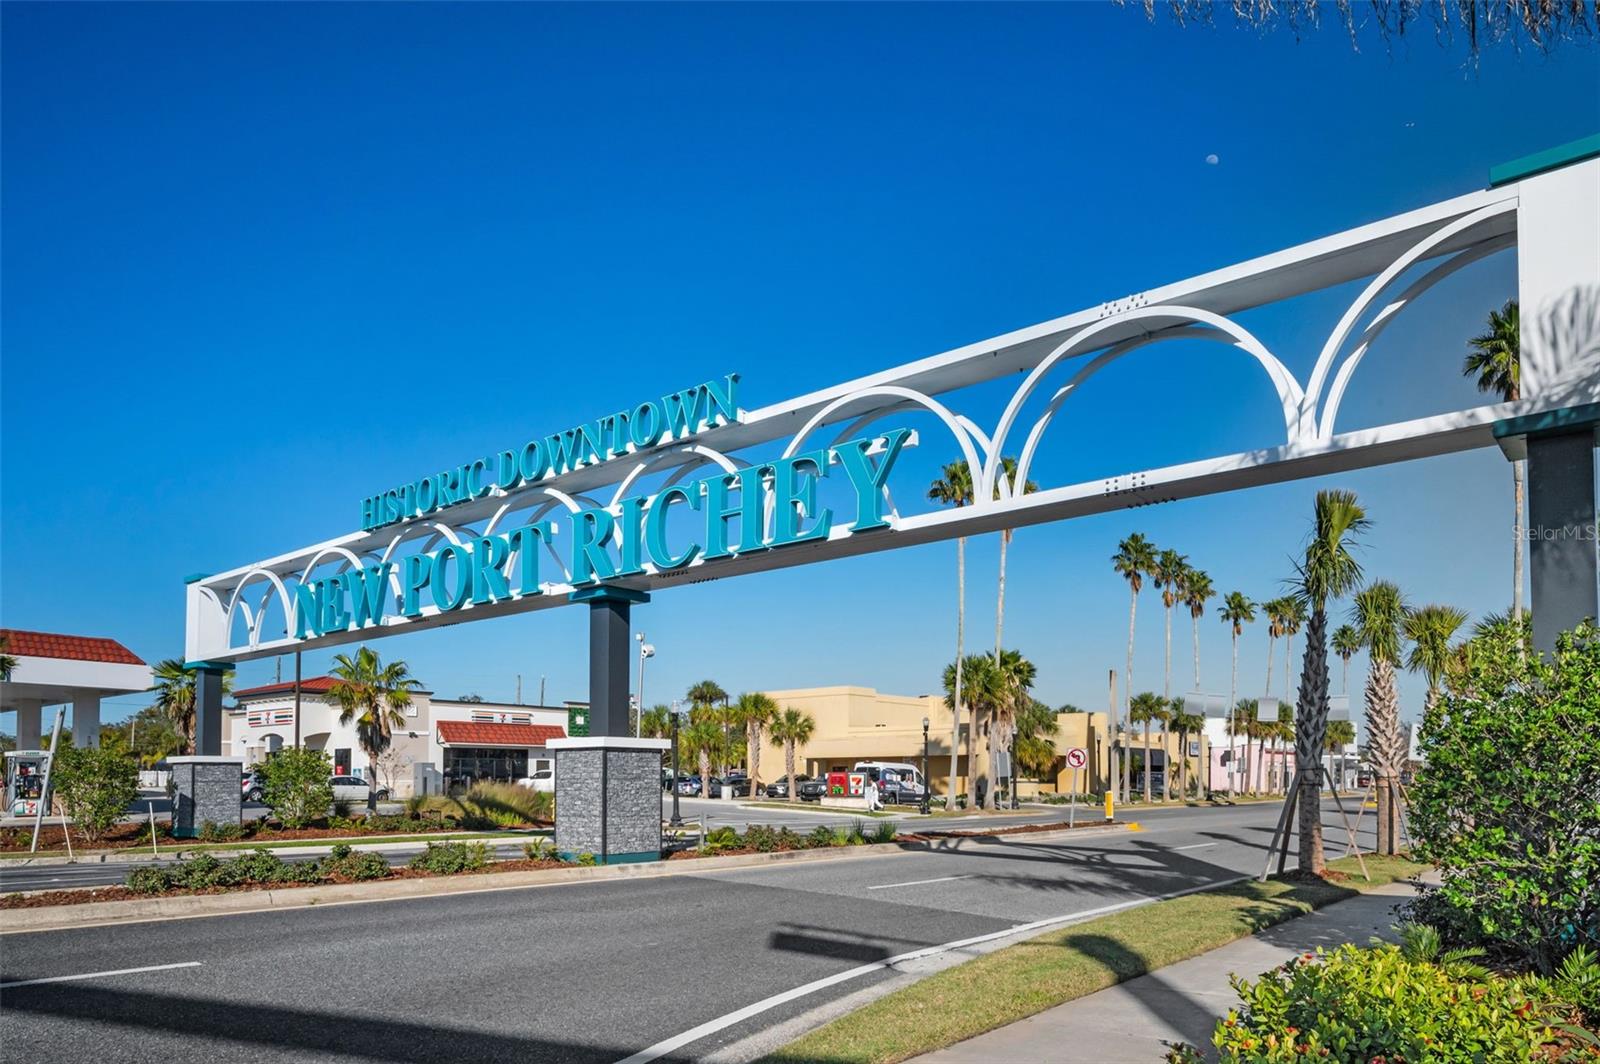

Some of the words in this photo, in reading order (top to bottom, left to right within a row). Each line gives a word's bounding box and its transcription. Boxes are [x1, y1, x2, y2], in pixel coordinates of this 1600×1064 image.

[294, 561, 393, 640] NEW
[401, 520, 552, 617] PORT
[568, 428, 912, 585] RICHEY
[360, 456, 493, 531] HISTORIC
[498, 372, 741, 490] DOWNTOWN
